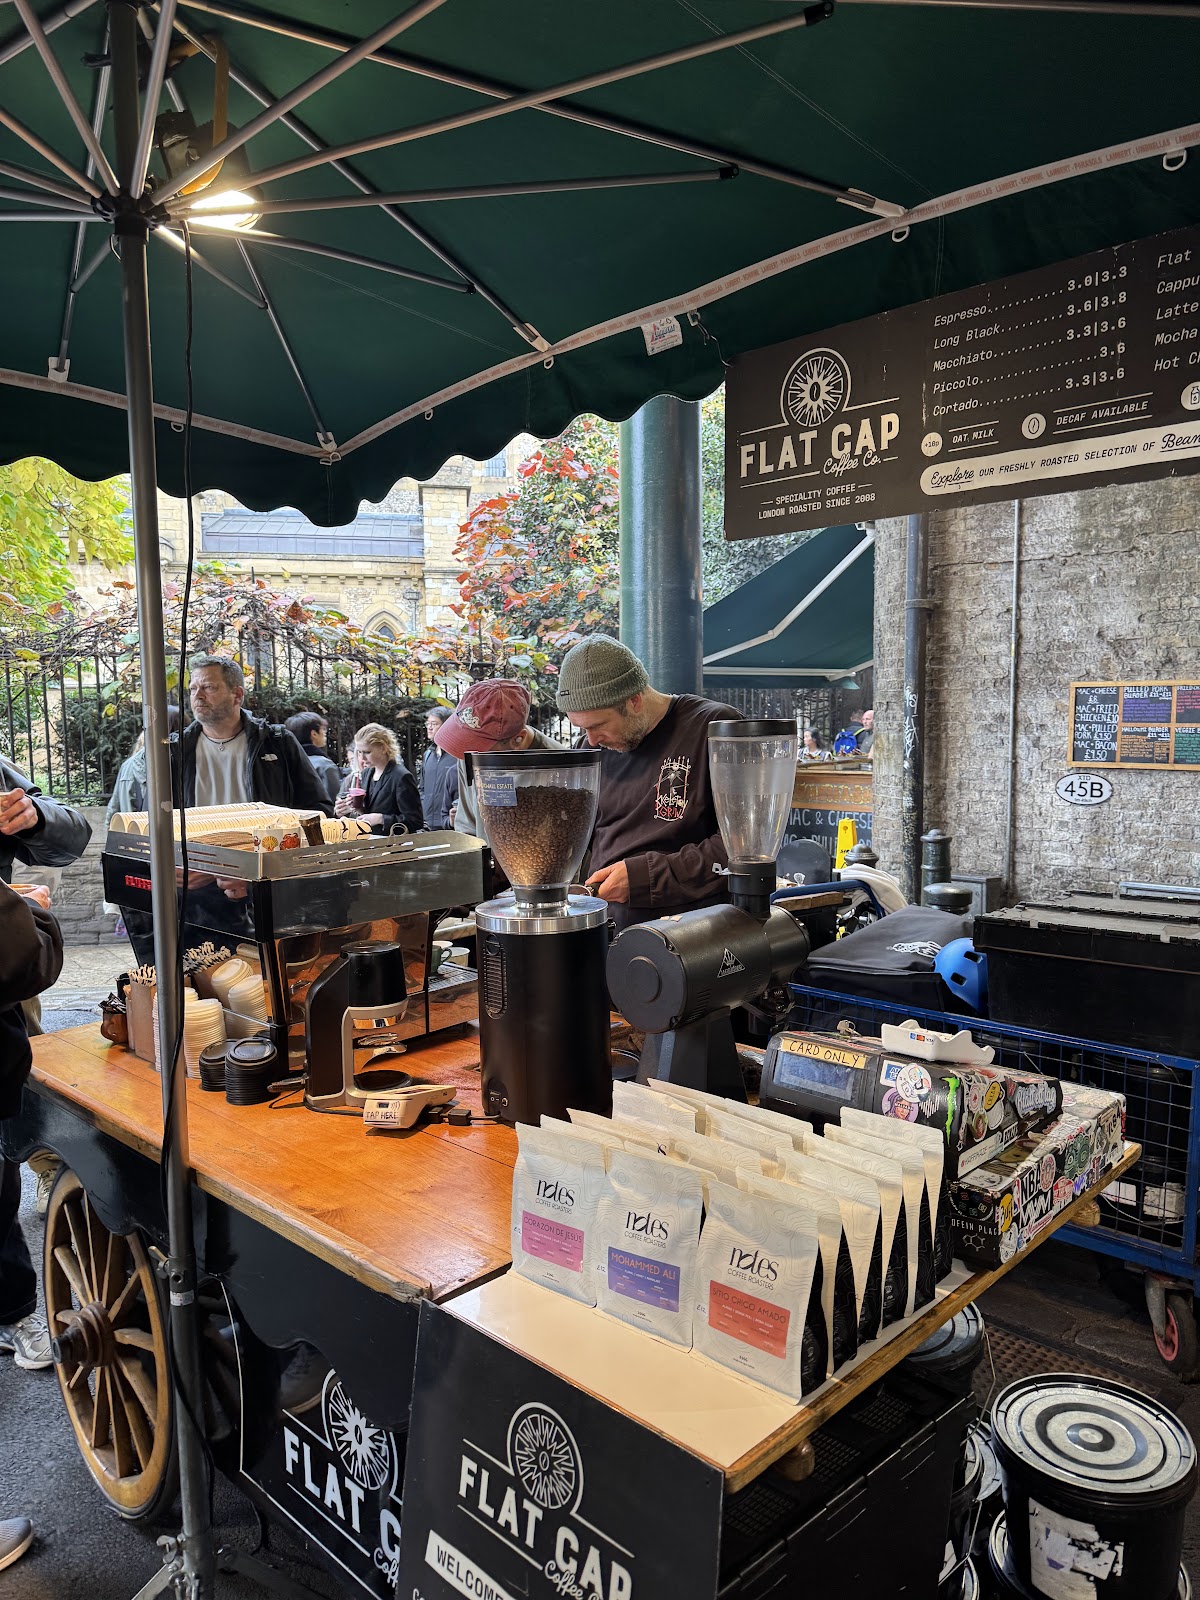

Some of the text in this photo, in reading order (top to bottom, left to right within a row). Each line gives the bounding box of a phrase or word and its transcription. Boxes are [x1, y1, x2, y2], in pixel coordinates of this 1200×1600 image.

[1157, 249, 1192, 268] Flat
[1155, 300, 1199, 320] Latte
[933, 334, 960, 350] Long
[1154, 327, 1198, 346] Mocha
[1154, 356, 1180, 371] Hot
[1056, 400, 1149, 426] DECAF AVAILABLE
[740, 412, 900, 478] FLAT CAP
[952, 428, 995, 444] OAT MILK
[823, 450, 882, 477] Coffee Co.
[930, 467, 974, 487] Explore
[979, 467, 995, 477] OUR
[999, 460, 1036, 475] FRESHLY
[1040, 454, 1079, 469] ROASTED
[1084, 446, 1137, 462] SELECTION
[1142, 442, 1156, 453] OF
[775, 483, 856, 505] SPECIALITY COFFEE
[758, 492, 876, 520] LONDON ROASTED SINCE 2008
[1075, 714, 1106, 722] CHICKEN
[1076, 705, 1091, 713] MAC
[1096, 704, 1119, 714] FRIED
[1092, 724, 1118, 733] PULLED
[1095, 741, 1117, 751] BACON
[1064, 780, 1103, 798] 45B
[815, 811, 823, 825] &
[789, 1040, 860, 1068] CARD ONLY
[366, 1111, 398, 1120] TAP HERE
[535, 1197, 573, 1215] COFFEE ROASTERS
[556, 1227, 564, 1237] DE
[951, 1218, 998, 1237] OFEIN PLAC
[624, 1230, 667, 1249] COFFEE ROASTERS
[611, 1252, 660, 1275] MOHAMMED
[662, 1269, 676, 1281] ALI
[727, 1267, 774, 1291] COFFEE ROASTERS
[696, 1304, 707, 1314] £12
[731, 1295, 756, 1312] CHICO
[757, 1307, 787, 1324] AMADO
[284, 1426, 365, 1534] FLAT
[459, 1454, 543, 1549] FLAT
[555, 1526, 632, 1600] CAP
[544, 1560, 583, 1600] Coffee
